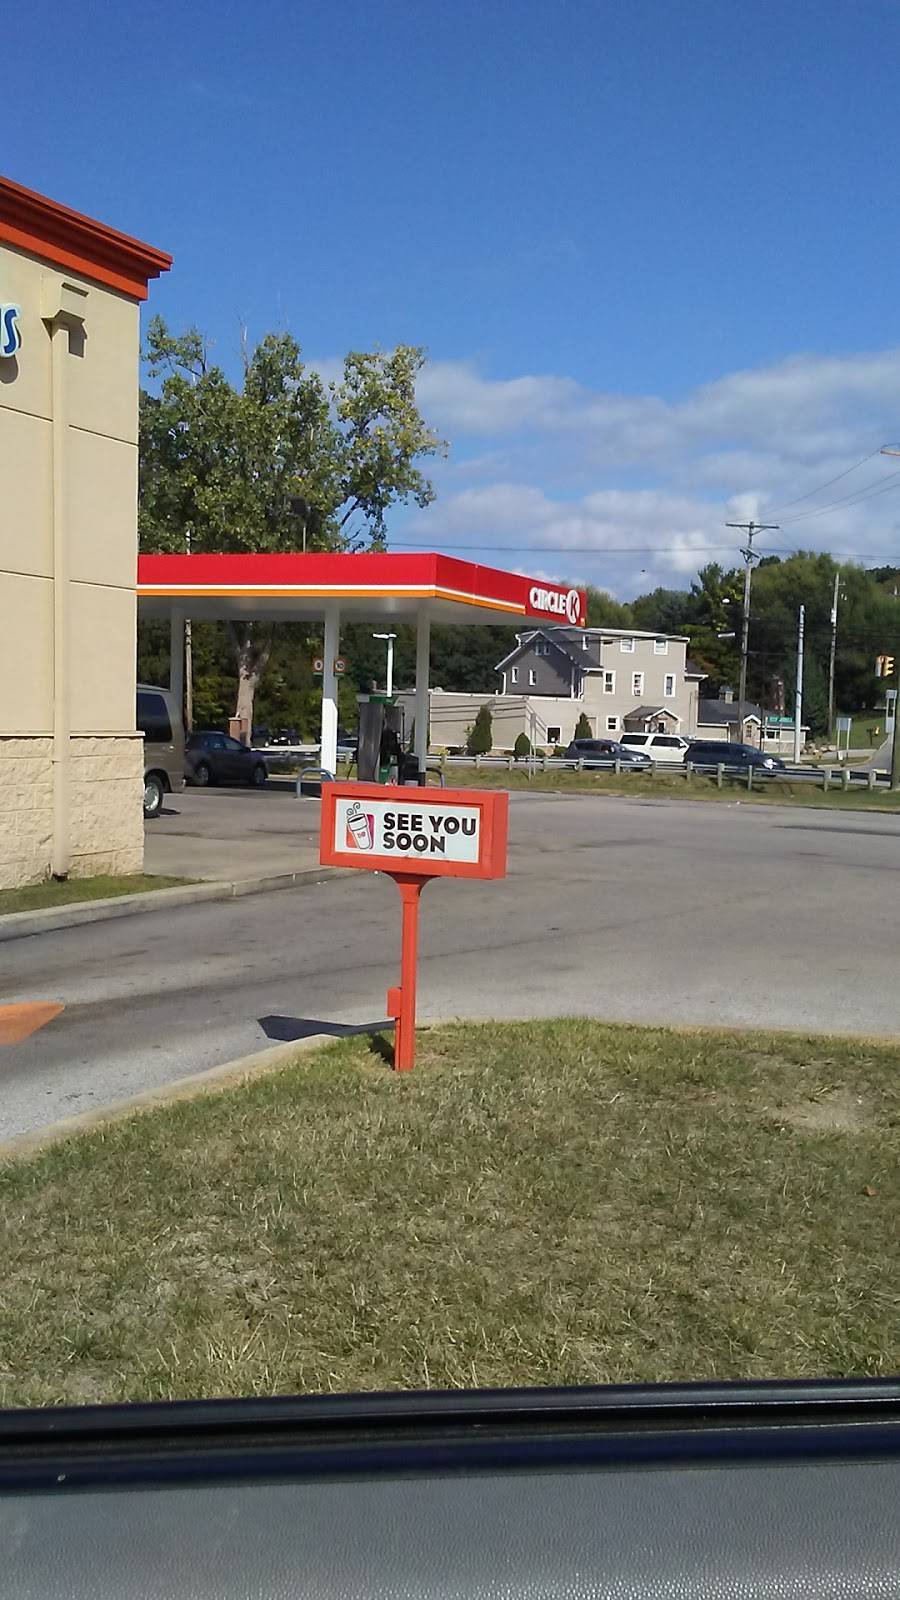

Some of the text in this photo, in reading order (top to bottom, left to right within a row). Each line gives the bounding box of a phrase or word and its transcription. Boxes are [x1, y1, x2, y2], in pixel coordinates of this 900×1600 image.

[0, 307, 19, 356] S
[529, 587, 580, 623] CIRCLE K
[383, 812, 477, 836] SEE YOU
[383, 832, 446, 853] SOON
